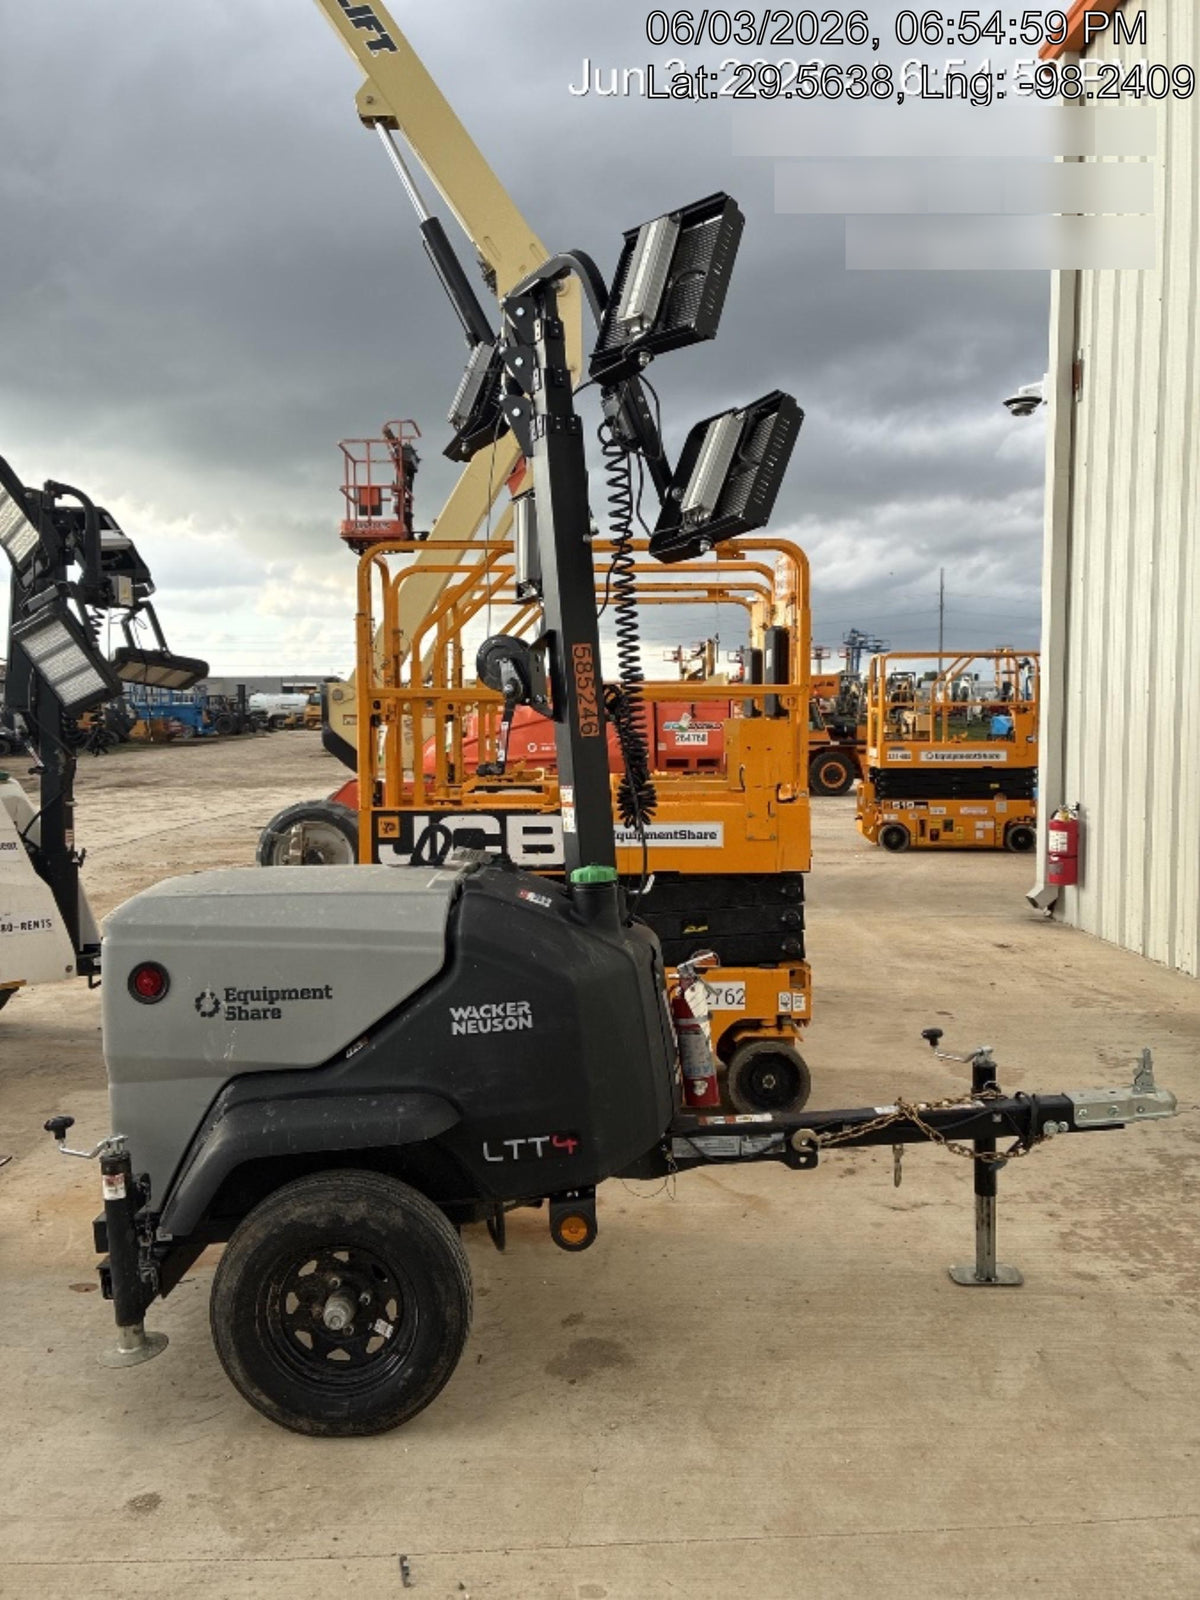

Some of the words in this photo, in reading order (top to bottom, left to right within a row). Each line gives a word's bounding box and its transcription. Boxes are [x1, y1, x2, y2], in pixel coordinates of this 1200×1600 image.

[574, 646, 598, 735] 585246
[378, 815, 566, 865] JCB
[614, 830, 718, 842] quipmentShare
[224, 984, 333, 1005] Equipment
[225, 1005, 282, 1021] Share
[450, 1001, 532, 1021] WACKER
[452, 1015, 533, 1035] NEUSON
[483, 1136, 577, 1162] LTT4
